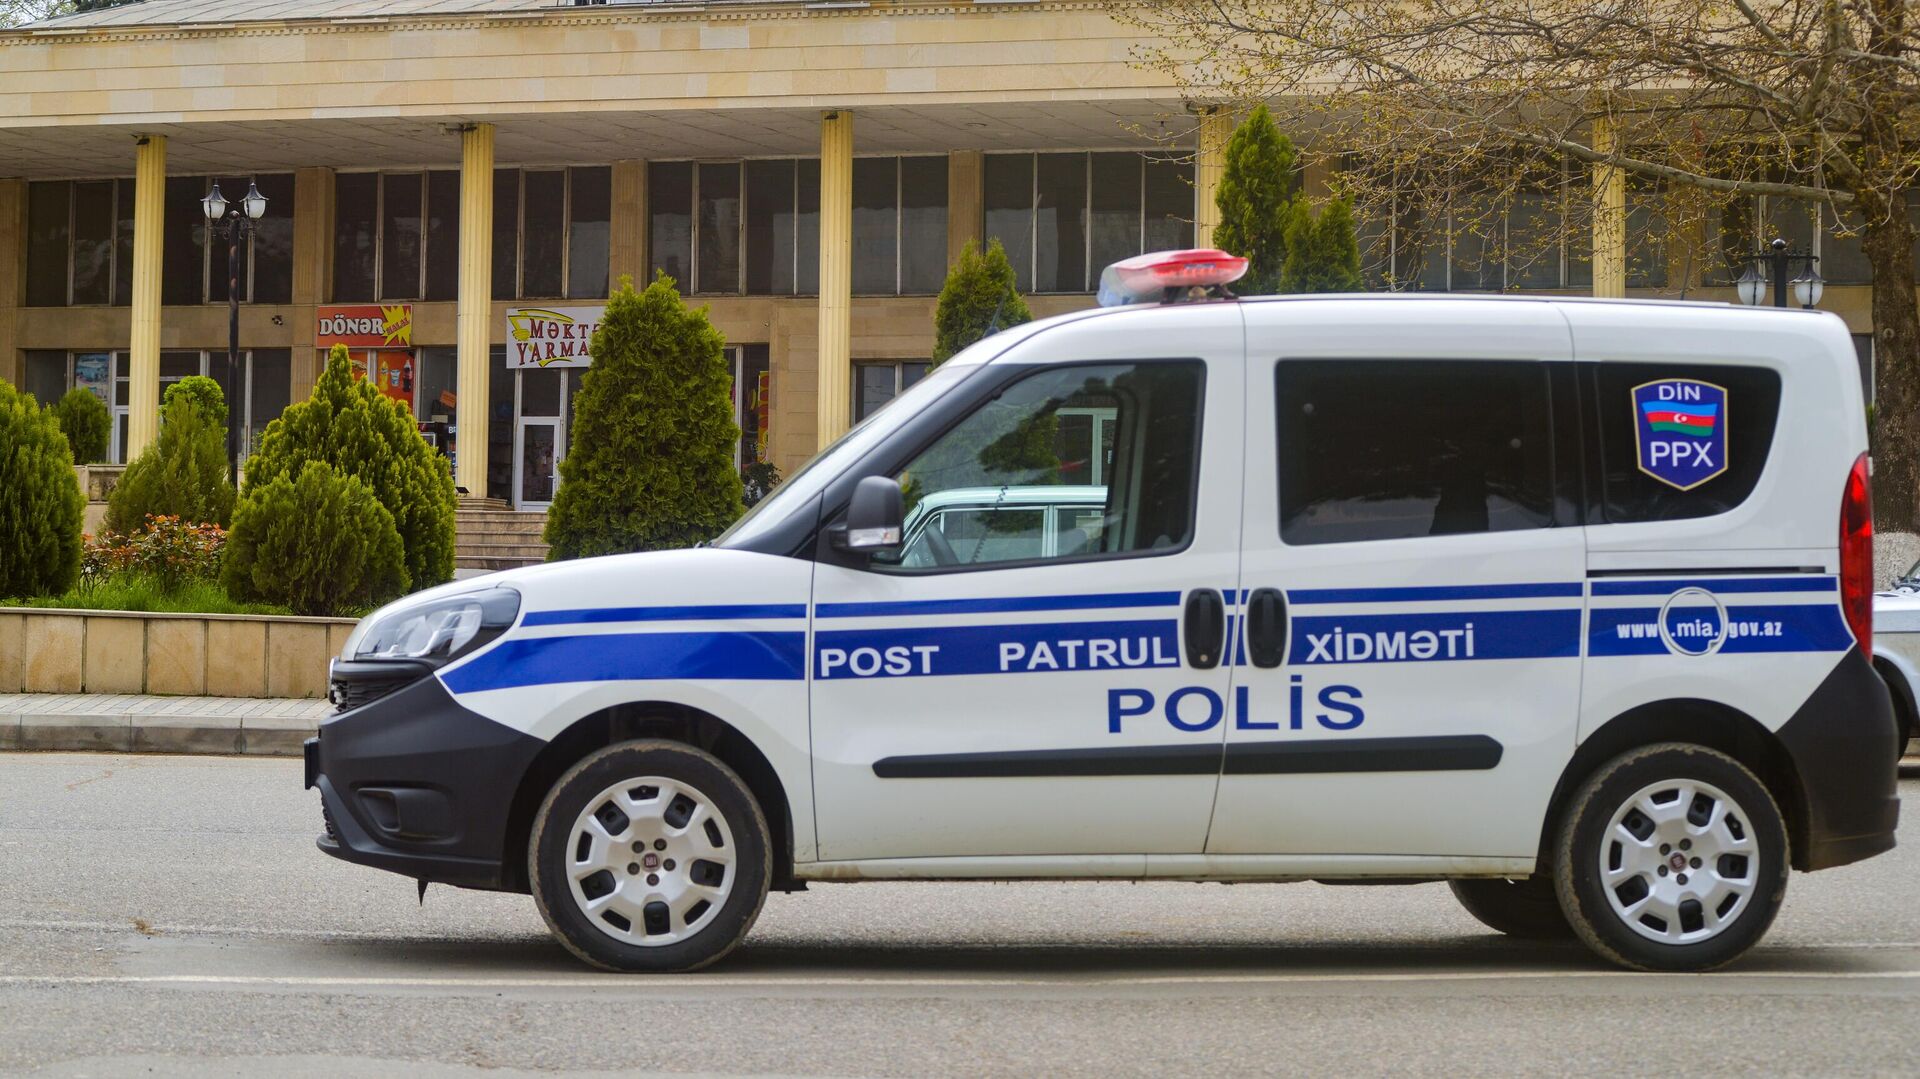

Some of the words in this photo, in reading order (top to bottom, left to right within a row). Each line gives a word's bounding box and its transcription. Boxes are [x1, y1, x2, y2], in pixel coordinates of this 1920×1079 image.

[516, 340, 590, 365] YARMA
[1658, 382, 1701, 401] DİN
[1650, 441, 1714, 467] PPX
[819, 645, 940, 678] POST
[999, 636, 1177, 671] PATRUL
[1107, 674, 1365, 733] POLİS
